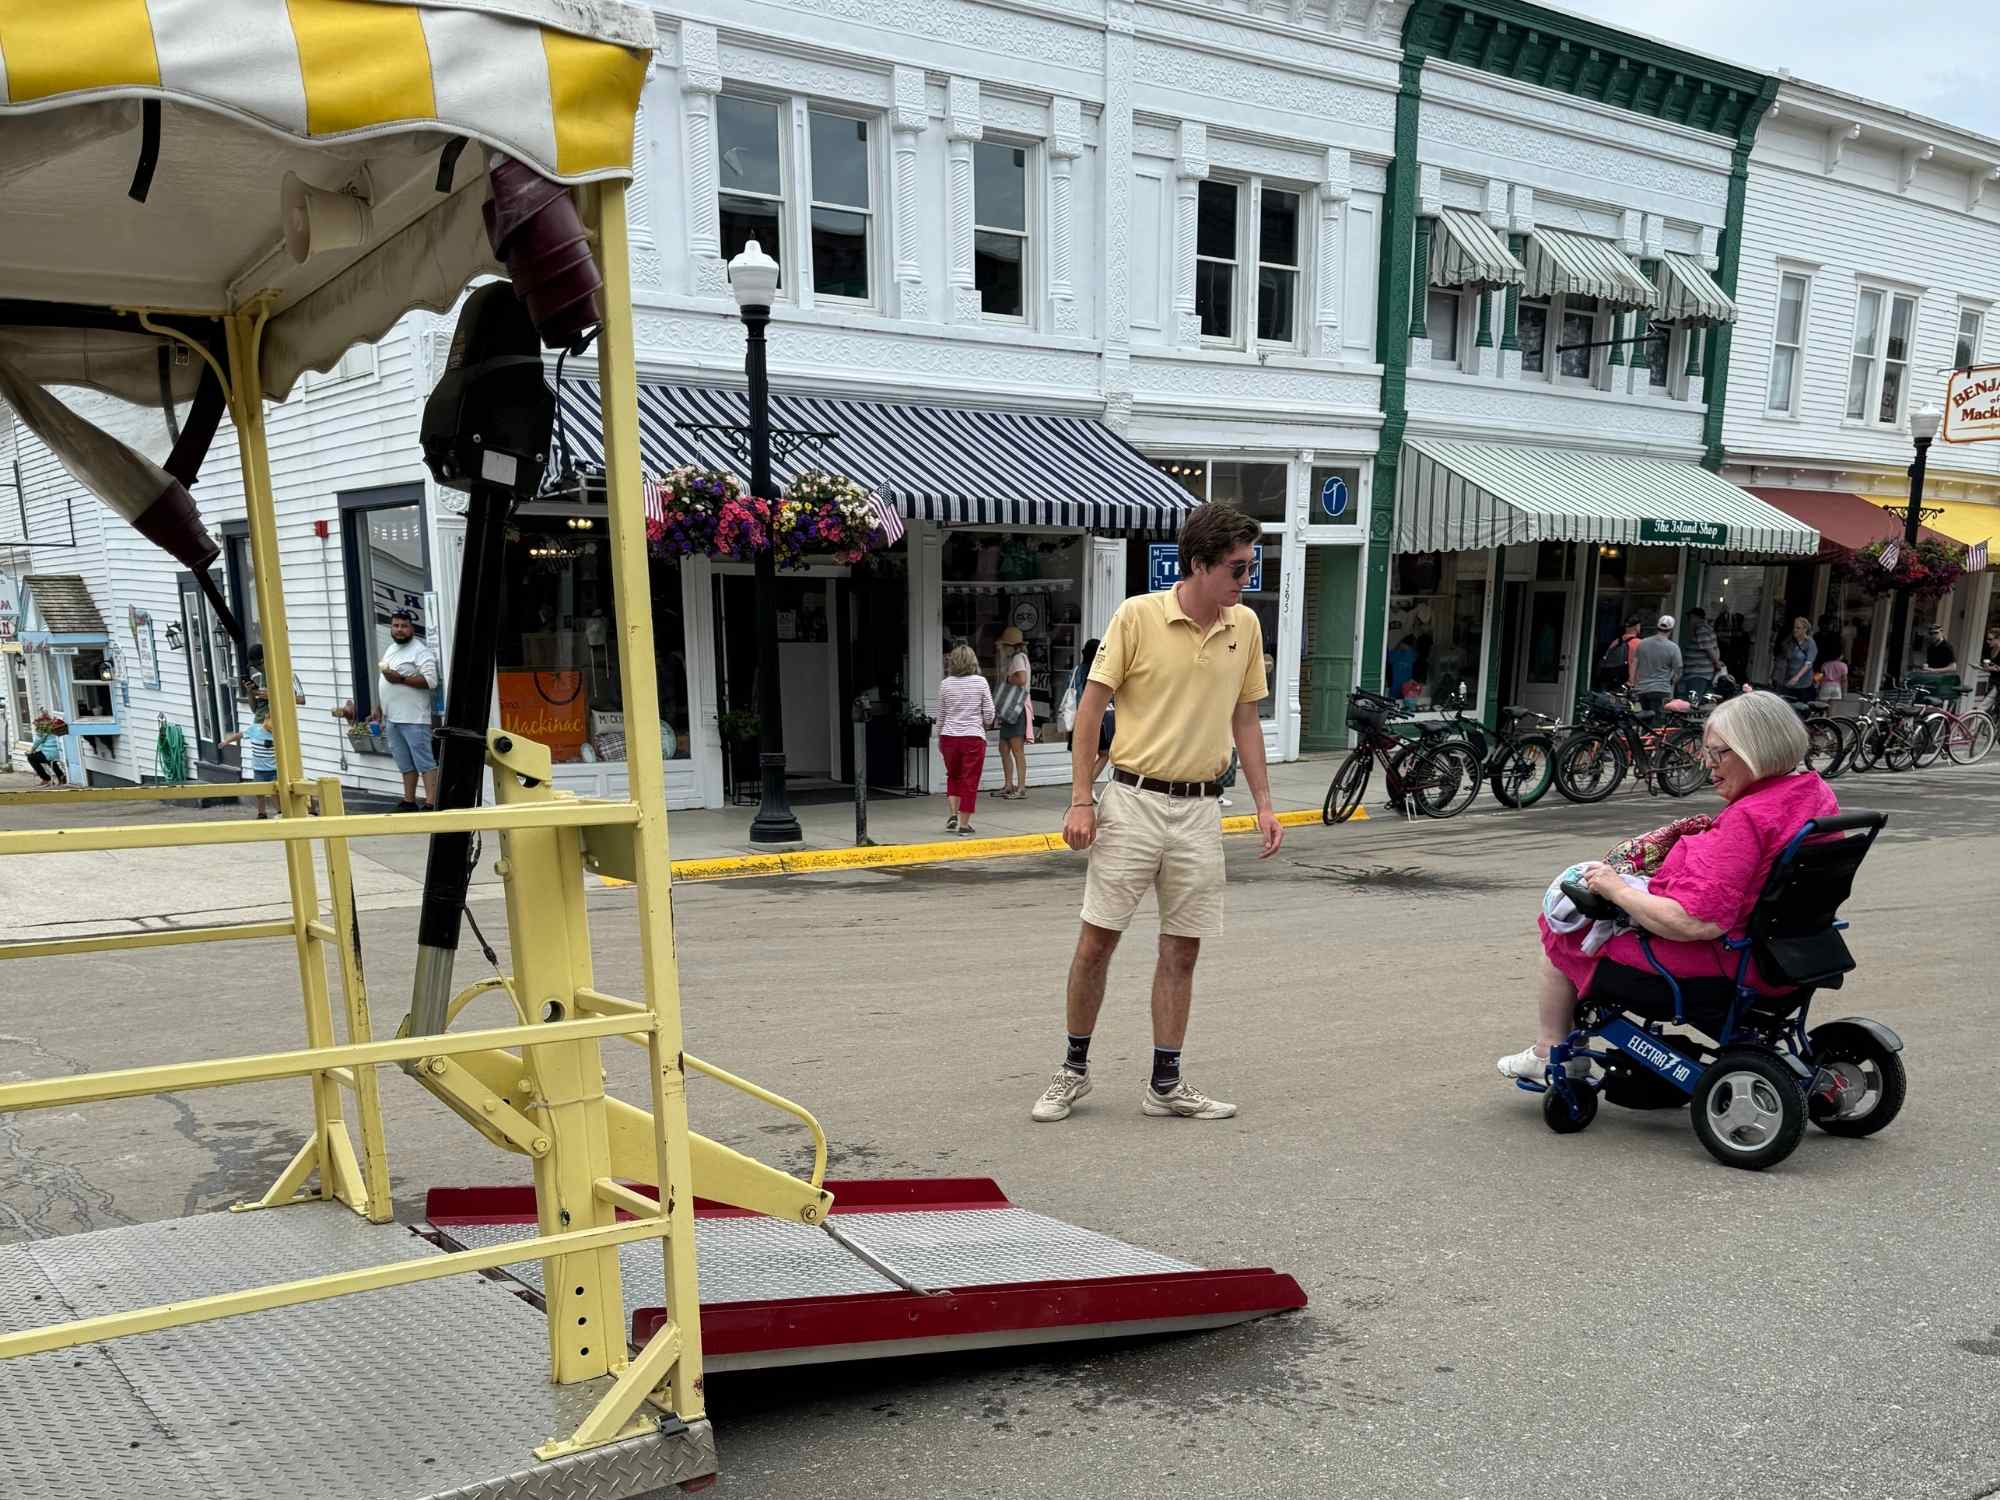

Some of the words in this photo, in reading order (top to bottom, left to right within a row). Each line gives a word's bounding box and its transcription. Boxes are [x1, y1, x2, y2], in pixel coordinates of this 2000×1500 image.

[1952, 378, 2000, 408] BENJ
[1654, 519, 1670, 533] The
[1670, 520, 1698, 534] Island
[1699, 522, 1718, 540] Shop
[1672, 1064, 1691, 1082] HD
